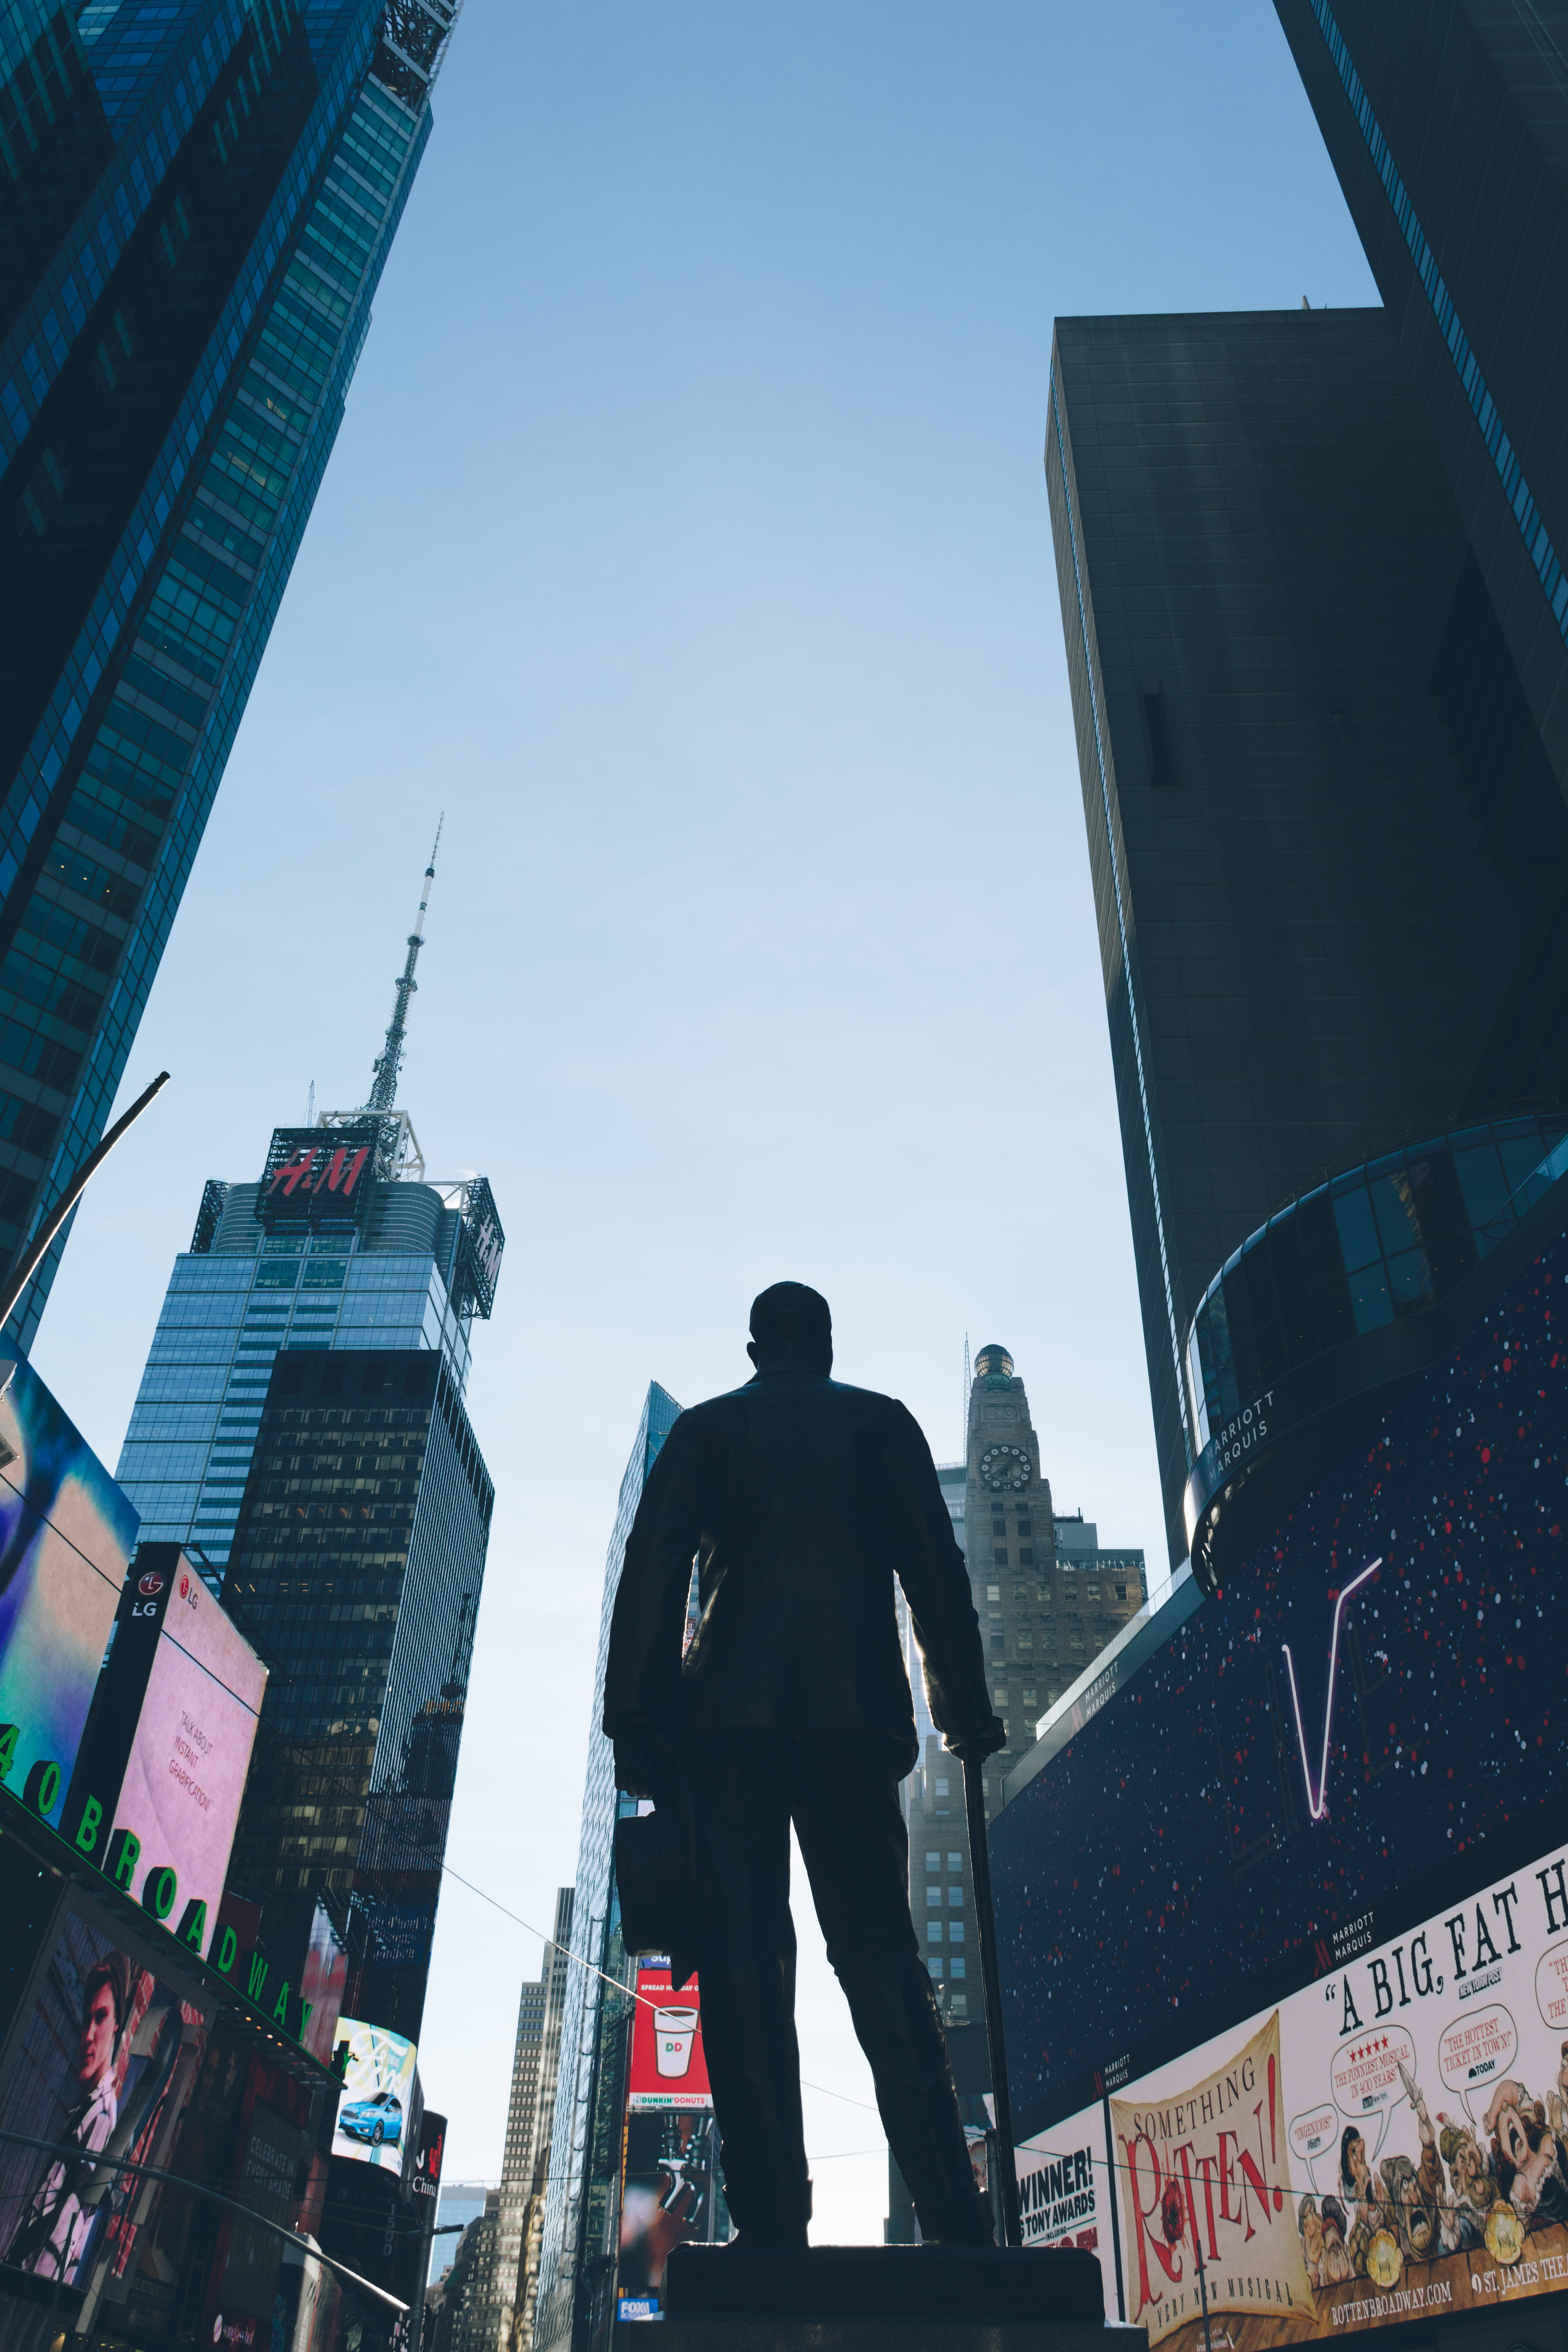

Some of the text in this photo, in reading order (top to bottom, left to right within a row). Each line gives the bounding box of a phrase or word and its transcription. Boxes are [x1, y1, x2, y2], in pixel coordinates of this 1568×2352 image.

[266, 1146, 370, 1196] H&M
[476, 1214, 502, 1293] H&M
[1207, 1390, 1274, 1463] MARRIOTT
[1209, 1420, 1268, 1485] MARQUIS
[132, 1602, 157, 1616] LG
[187, 1588, 198, 1610] LG
[1085, 1661, 1118, 1703] MARRIOTT
[1087, 1682, 1116, 1719] MARQUIS
[174, 1735, 198, 1768] INSTANT
[181, 1710, 212, 1757] TALK ABOUT
[169, 1759, 210, 1812] GRABIFICATION!
[76, 1794, 313, 2042] BROADWAY
[1333, 1912, 1373, 1944] MARRIOTT
[1335, 1931, 1372, 1960] MARQUIS
[1367, 1931, 1443, 2018] BIG,
[1445, 1881, 1521, 1980] FAT
[1459, 1966, 1502, 2000] NEW YORK POST
[1548, 1998, 1566, 2019] THE
[666, 2043, 682, 2052] DD
[1465, 2018, 1499, 2045] HOTTEST
[1105, 2054, 1129, 2076] MARRIOTT
[1334, 2044, 1410, 2088] THE FUNNIEST MUSICAL
[1444, 2048, 1472, 2072] TICKET
[1472, 2043, 1482, 2061] IN
[1475, 2059, 1495, 2075] TODAY
[1106, 2069, 1128, 2089] MARQUIS
[1351, 2083, 1359, 2098] IN
[1360, 2078, 1372, 2094] 400
[1134, 2056, 1255, 2143] SOMETHING
[251, 2136, 287, 2173] CELEBRATE
[287, 2157, 295, 2176] IN
[246, 2159, 291, 2200] EVERY SHADE
[413, 2176, 436, 2197] China
[1017, 2145, 1093, 2217] WINNER!
[1025, 2207, 1051, 2238] TONY
[1053, 2189, 1095, 2227] AWARDS
[1045, 2225, 1067, 2241] INCLUDING
[1483, 2270, 1500, 2294] ST.
[1500, 2260, 1540, 2295] JAMES
[621, 2301, 645, 2314] FOX
[1157, 2277, 1293, 2328] VERY NW MUSICAL
[1331, 2281, 1453, 2326] ROTTENBROADWAY.COM
